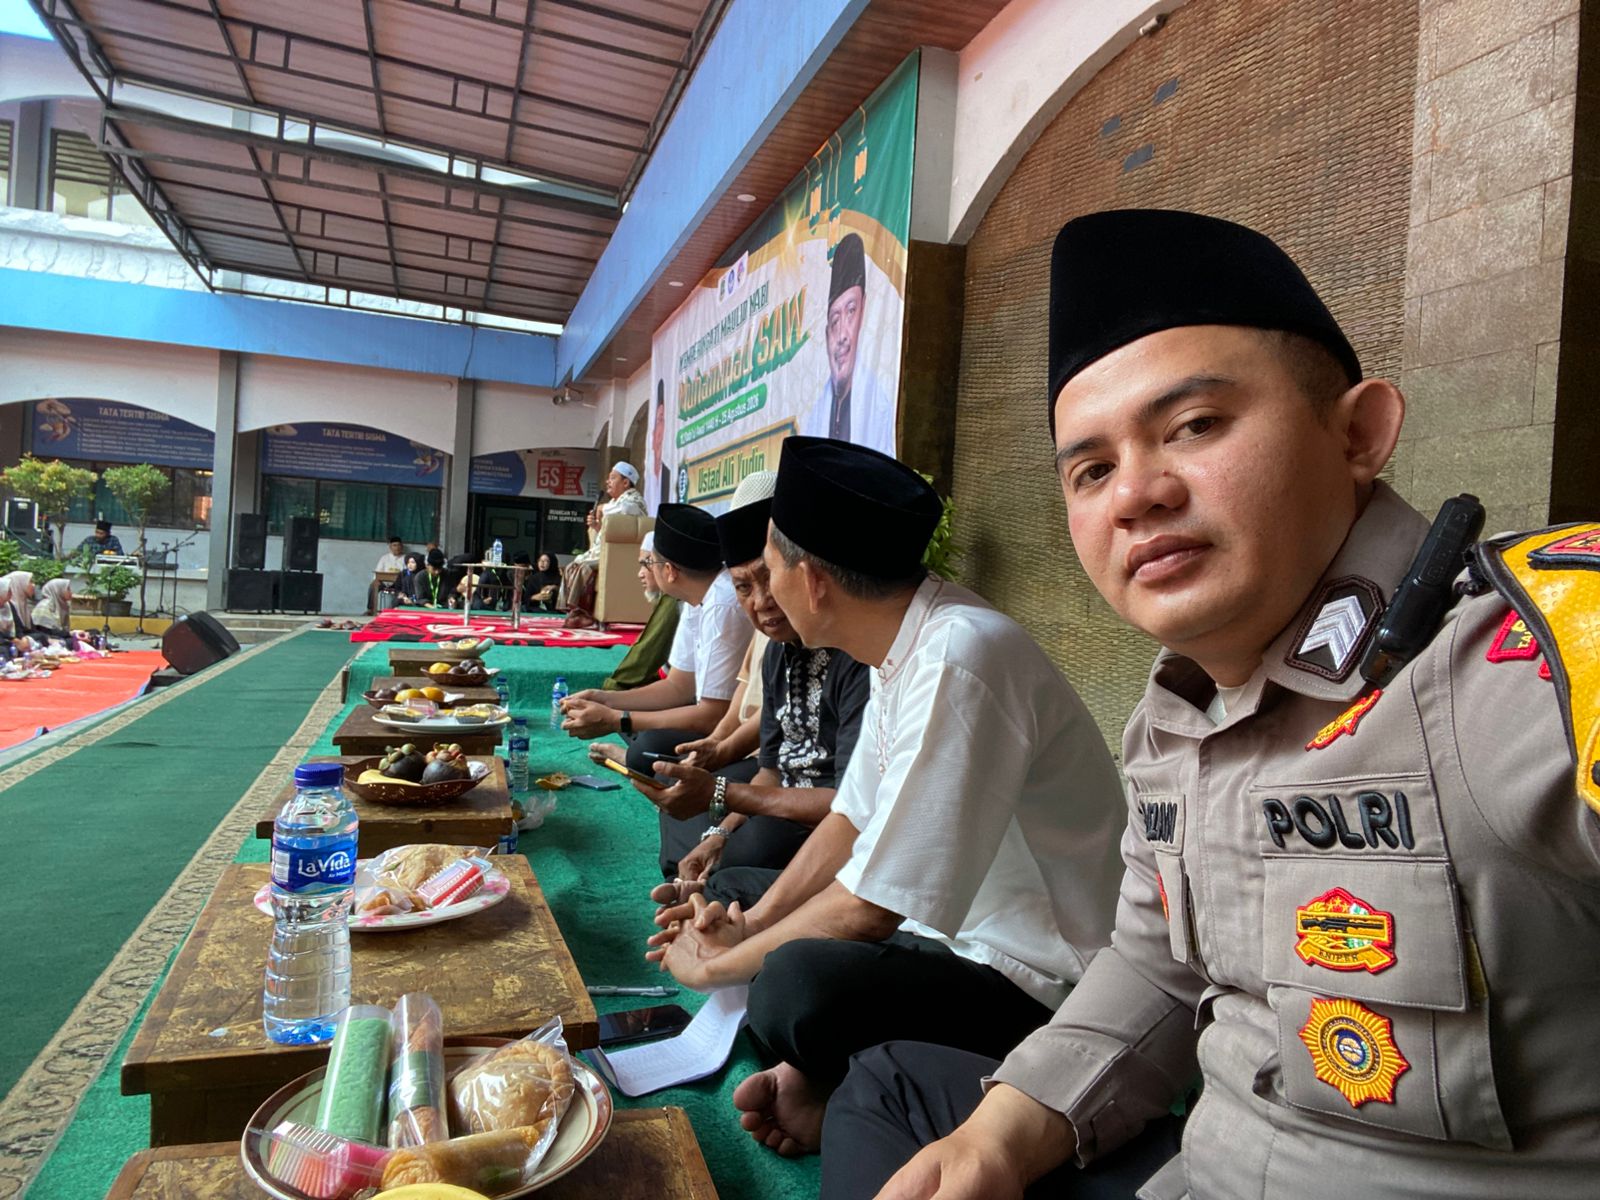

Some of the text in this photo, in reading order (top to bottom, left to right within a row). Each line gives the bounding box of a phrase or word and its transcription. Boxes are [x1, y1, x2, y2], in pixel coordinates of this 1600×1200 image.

[749, 281, 769, 316] NABI
[757, 284, 808, 366] SAW
[99, 407, 119, 418] TATA
[322, 428, 341, 438] TATA
[540, 467, 560, 487] 5S
[722, 455, 735, 487] Ali
[1263, 791, 1416, 850] POLRI
[298, 851, 351, 878] LaVida
[1319, 949, 1359, 963] SNIPER
